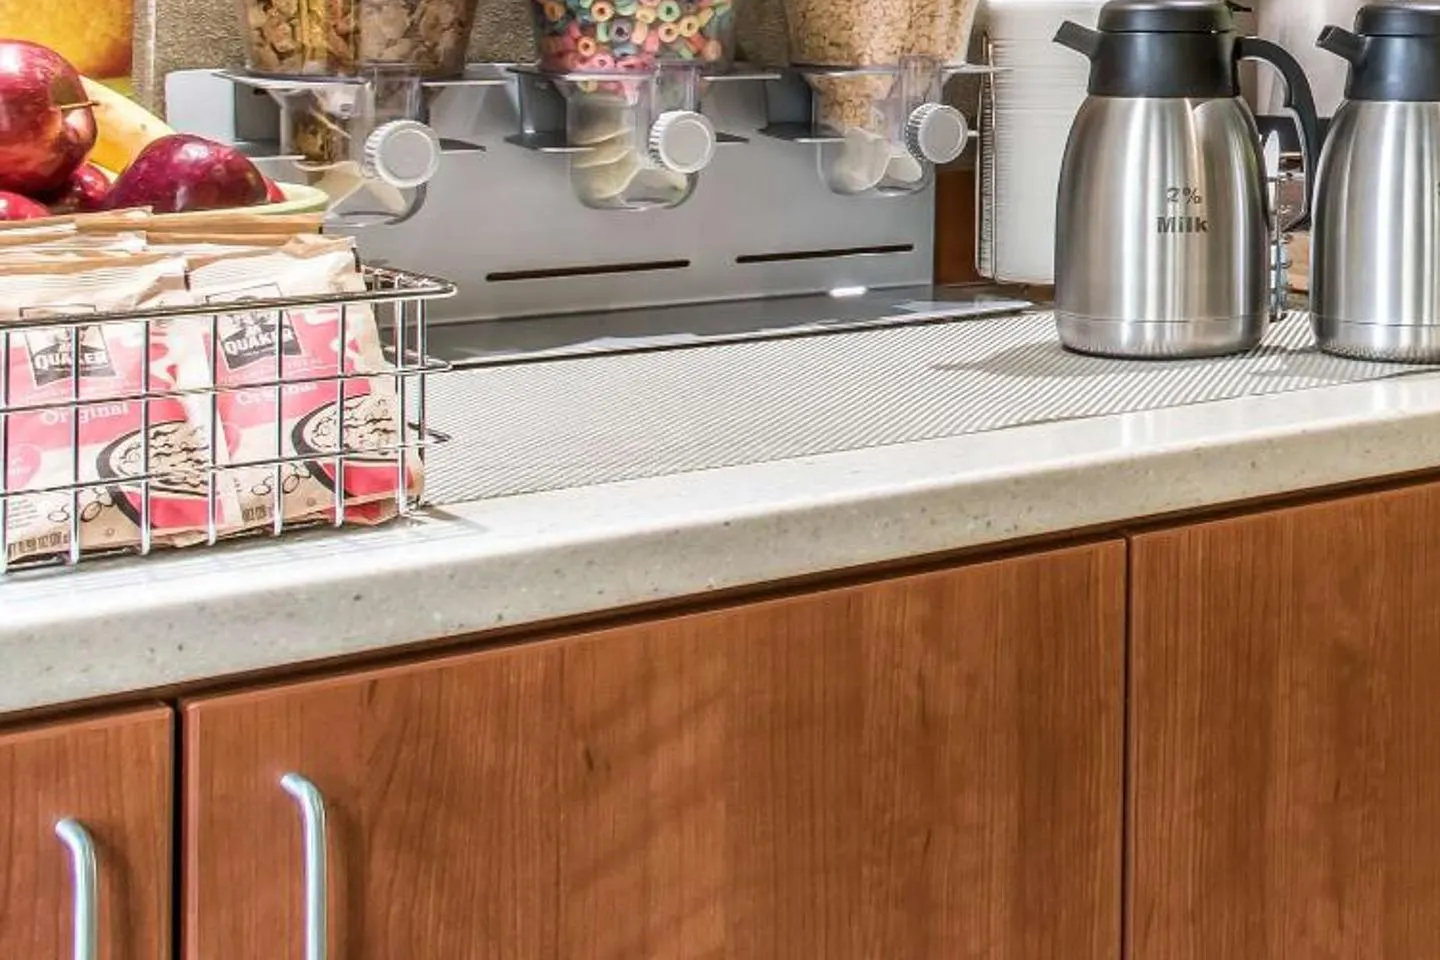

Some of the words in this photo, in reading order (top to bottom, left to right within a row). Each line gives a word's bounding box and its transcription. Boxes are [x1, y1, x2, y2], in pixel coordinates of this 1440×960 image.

[1167, 187, 1202, 205] 2%
[1157, 216, 1209, 233] Milk
[42, 403, 130, 426] Orginal
